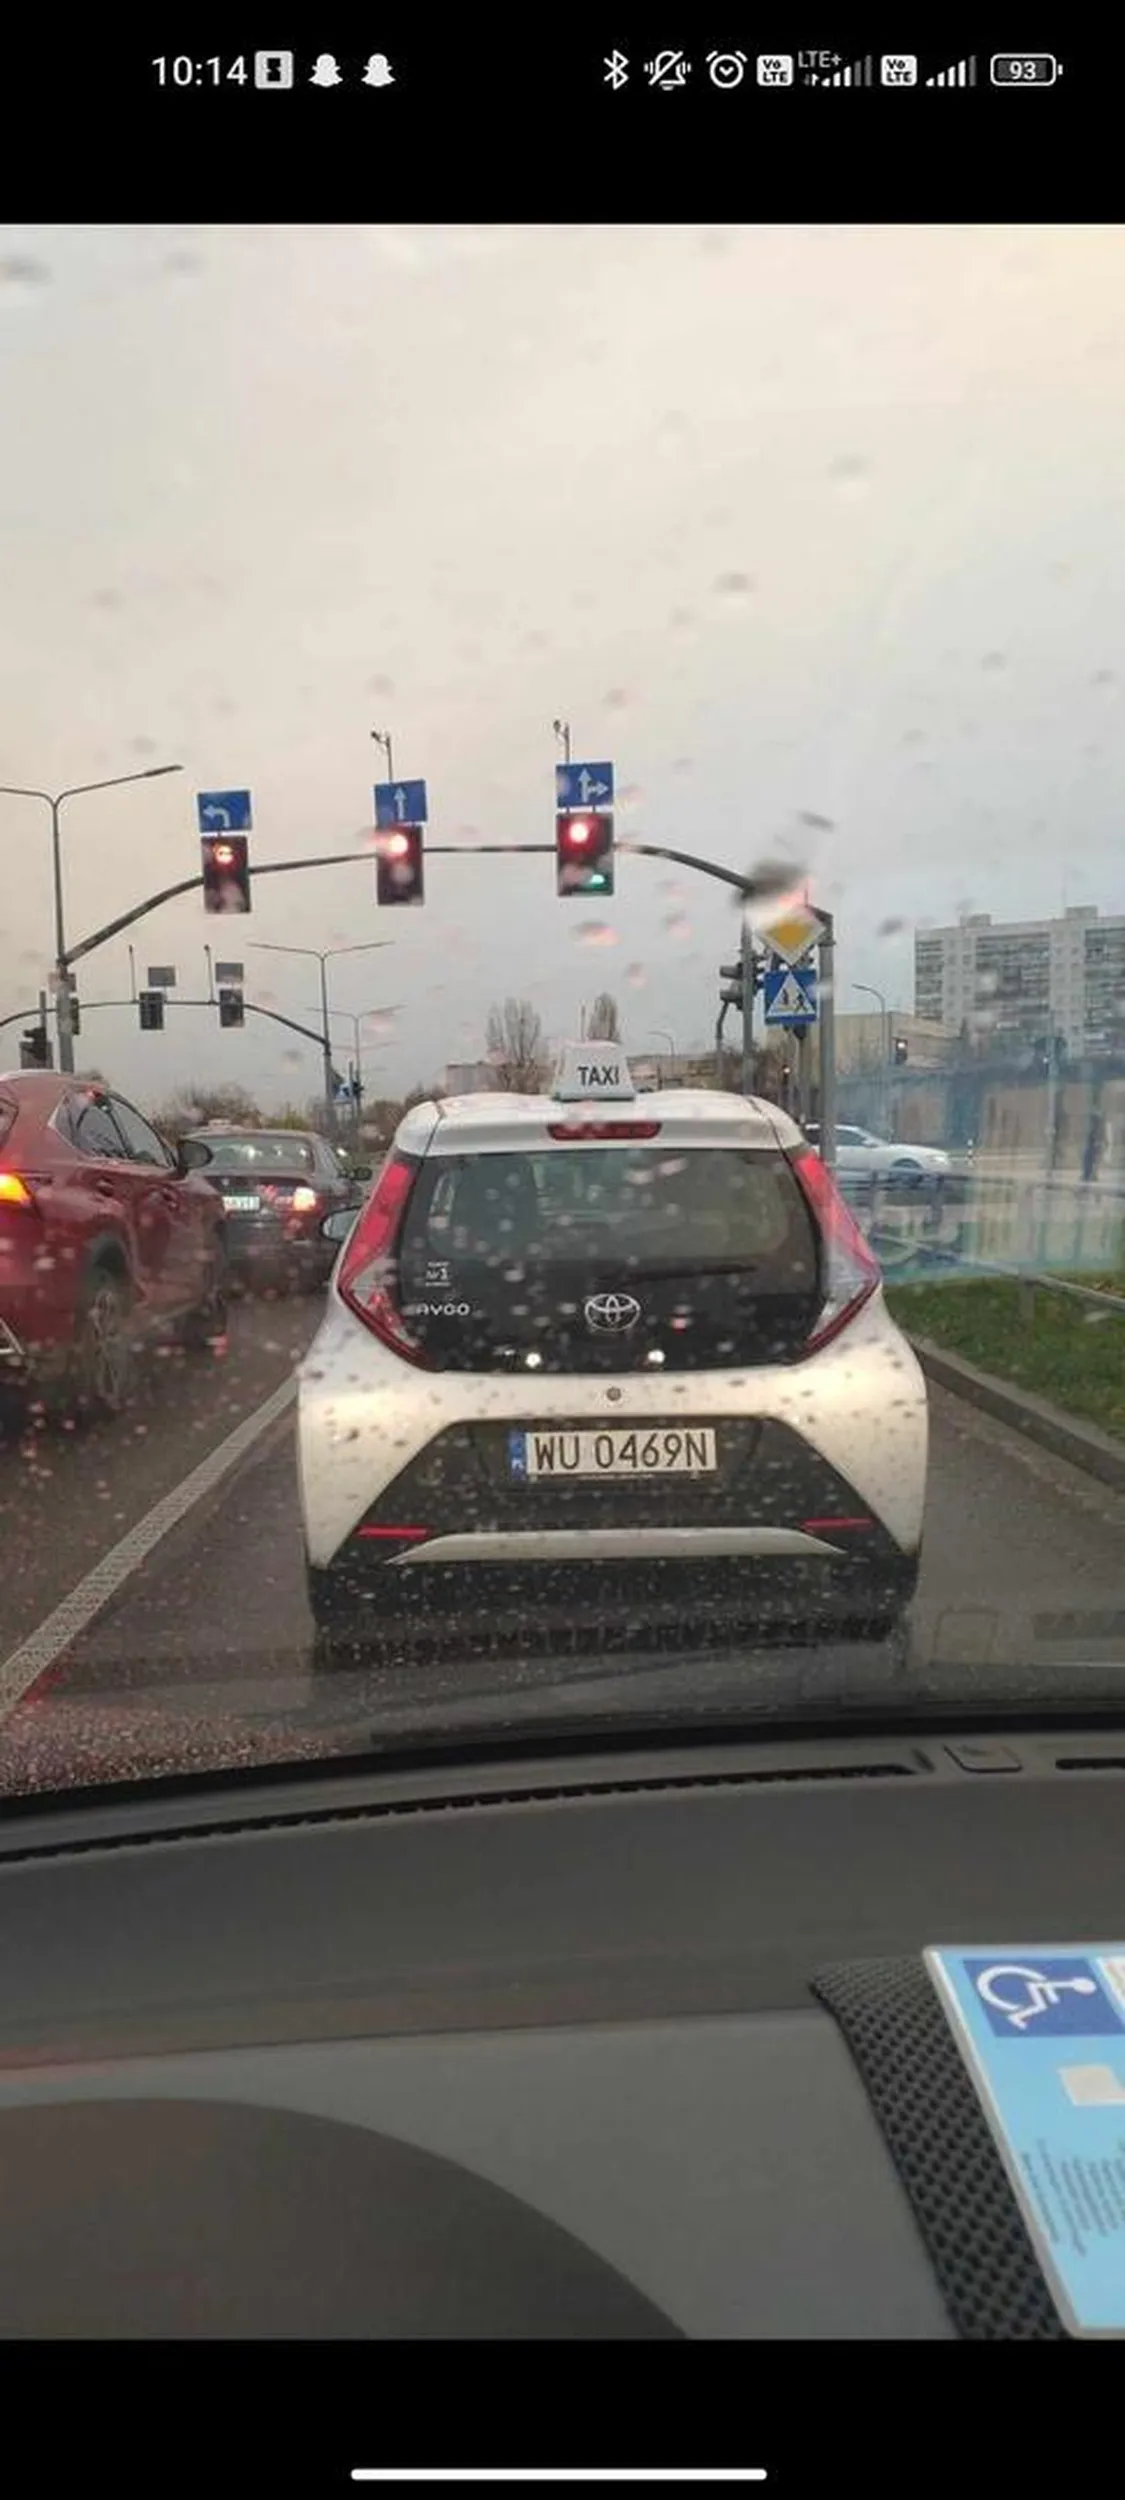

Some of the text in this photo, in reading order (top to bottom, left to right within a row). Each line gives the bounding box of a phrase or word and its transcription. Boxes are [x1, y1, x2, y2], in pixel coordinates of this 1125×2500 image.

[577, 1066, 620, 1086] TAXI
[534, 1432, 708, 1471] WU 0469N
